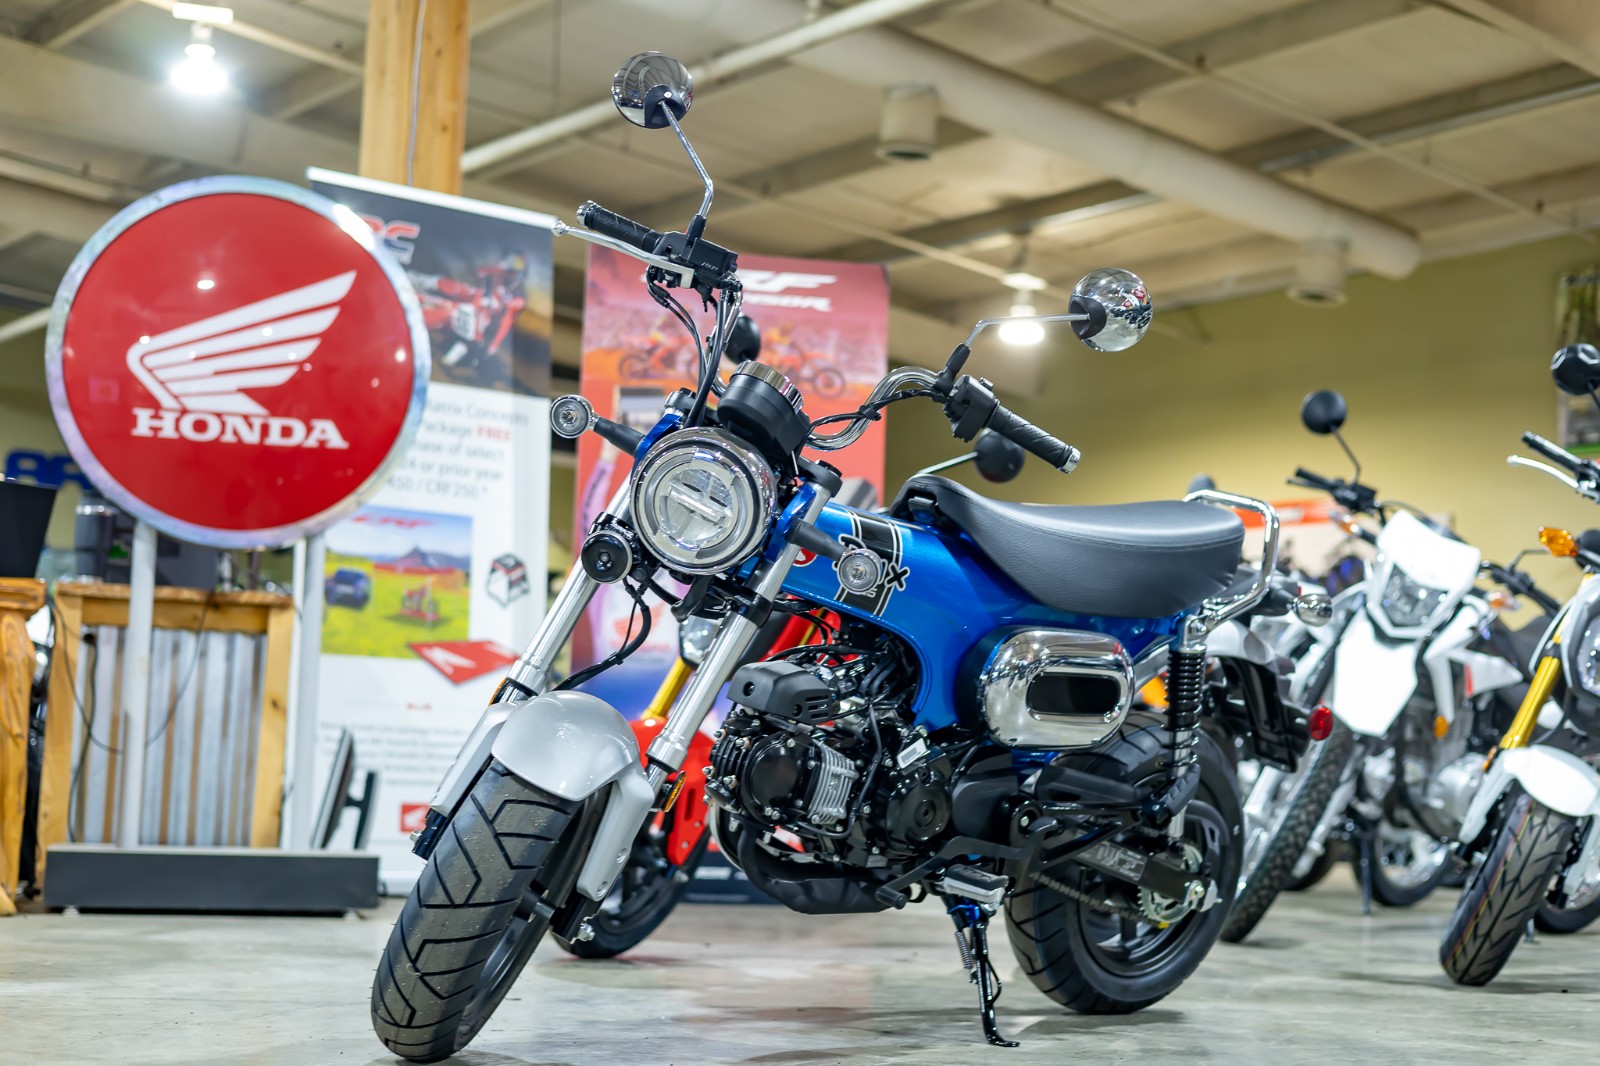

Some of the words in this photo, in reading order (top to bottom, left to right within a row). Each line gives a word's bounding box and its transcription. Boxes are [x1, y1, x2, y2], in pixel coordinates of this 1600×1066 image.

[426, 401, 462, 416] atrix
[131, 407, 349, 449] HONDA
[476, 423, 511, 441] FREE
[447, 441, 464, 455] of
[466, 447, 505, 461] select
